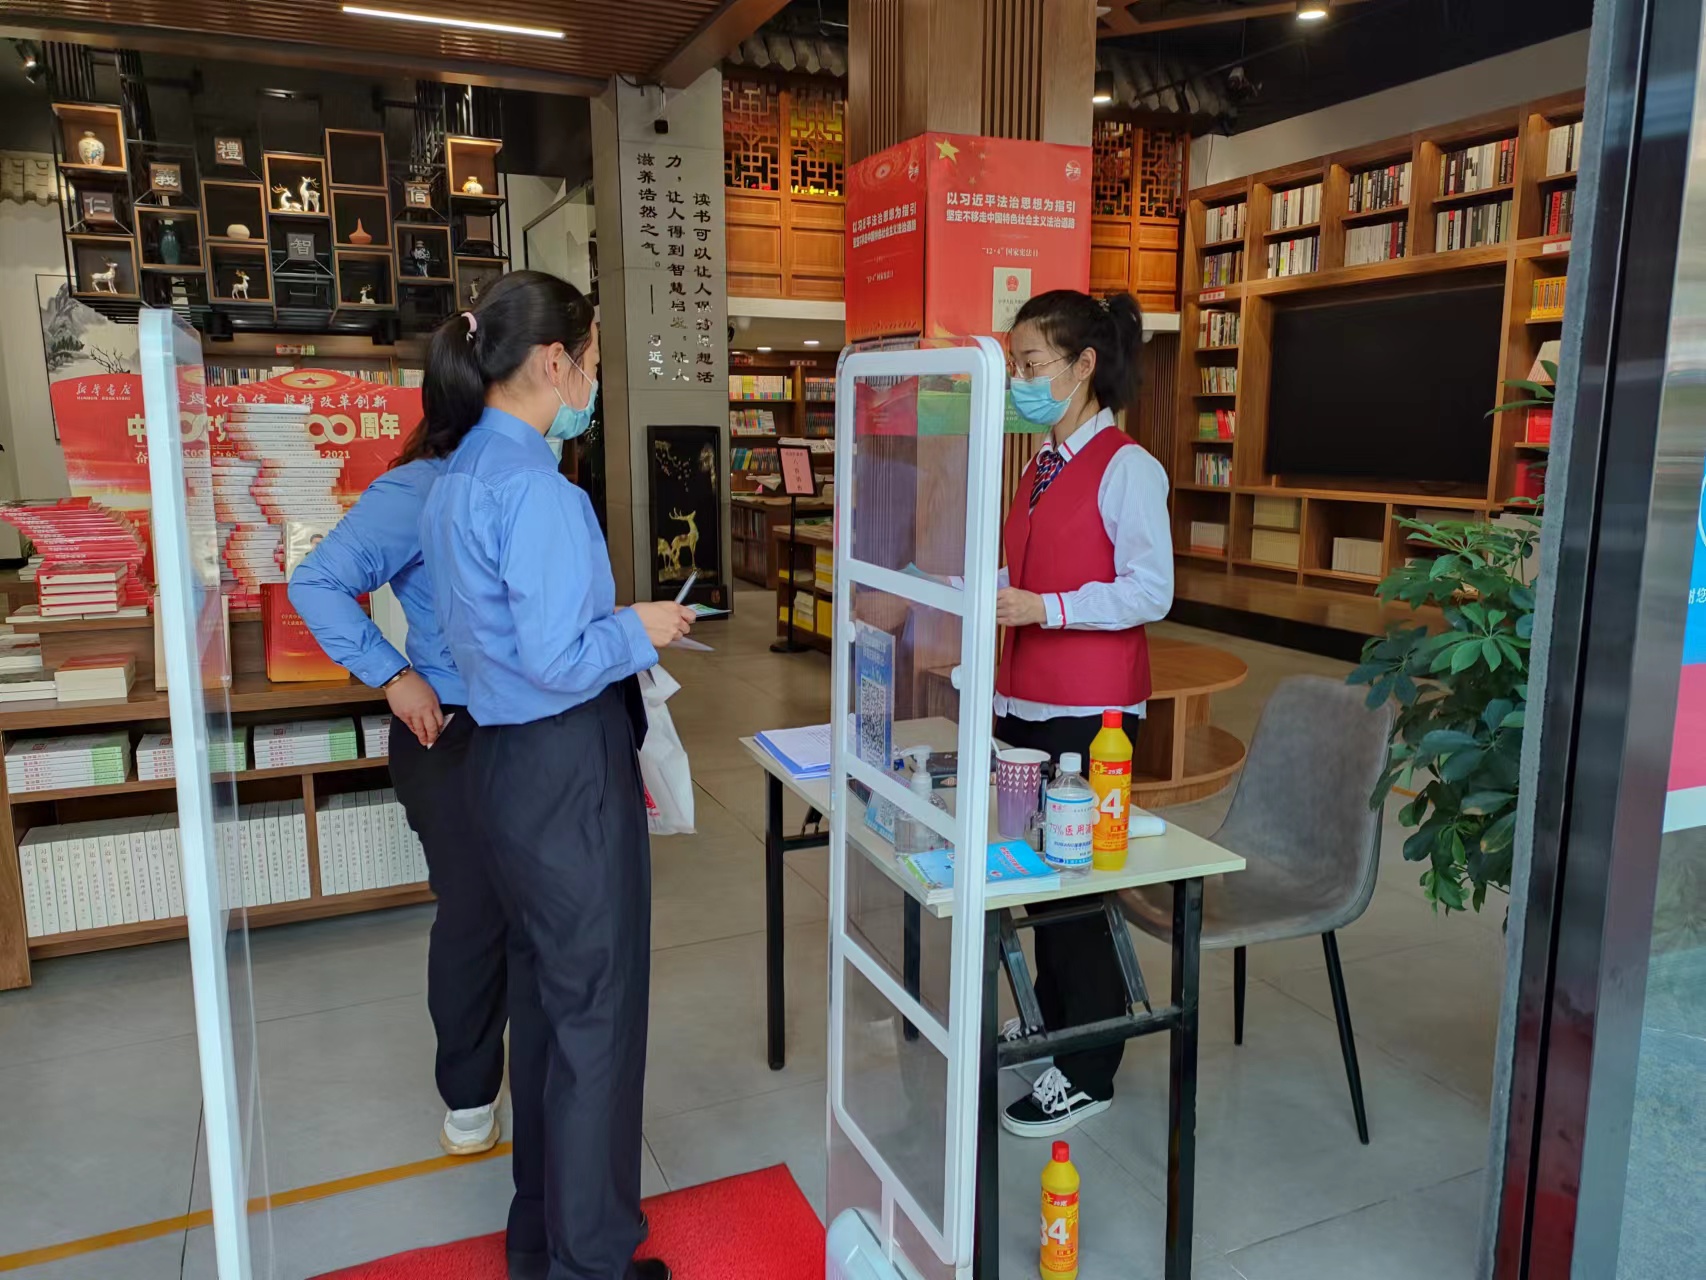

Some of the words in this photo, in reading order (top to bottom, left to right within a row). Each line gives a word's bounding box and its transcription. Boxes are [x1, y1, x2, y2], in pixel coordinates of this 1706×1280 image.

[946, 191, 1076, 214] 以习近平法治思想为指引
[946, 209, 1076, 230] 坚定不移走中国特色社会主义法治道路
